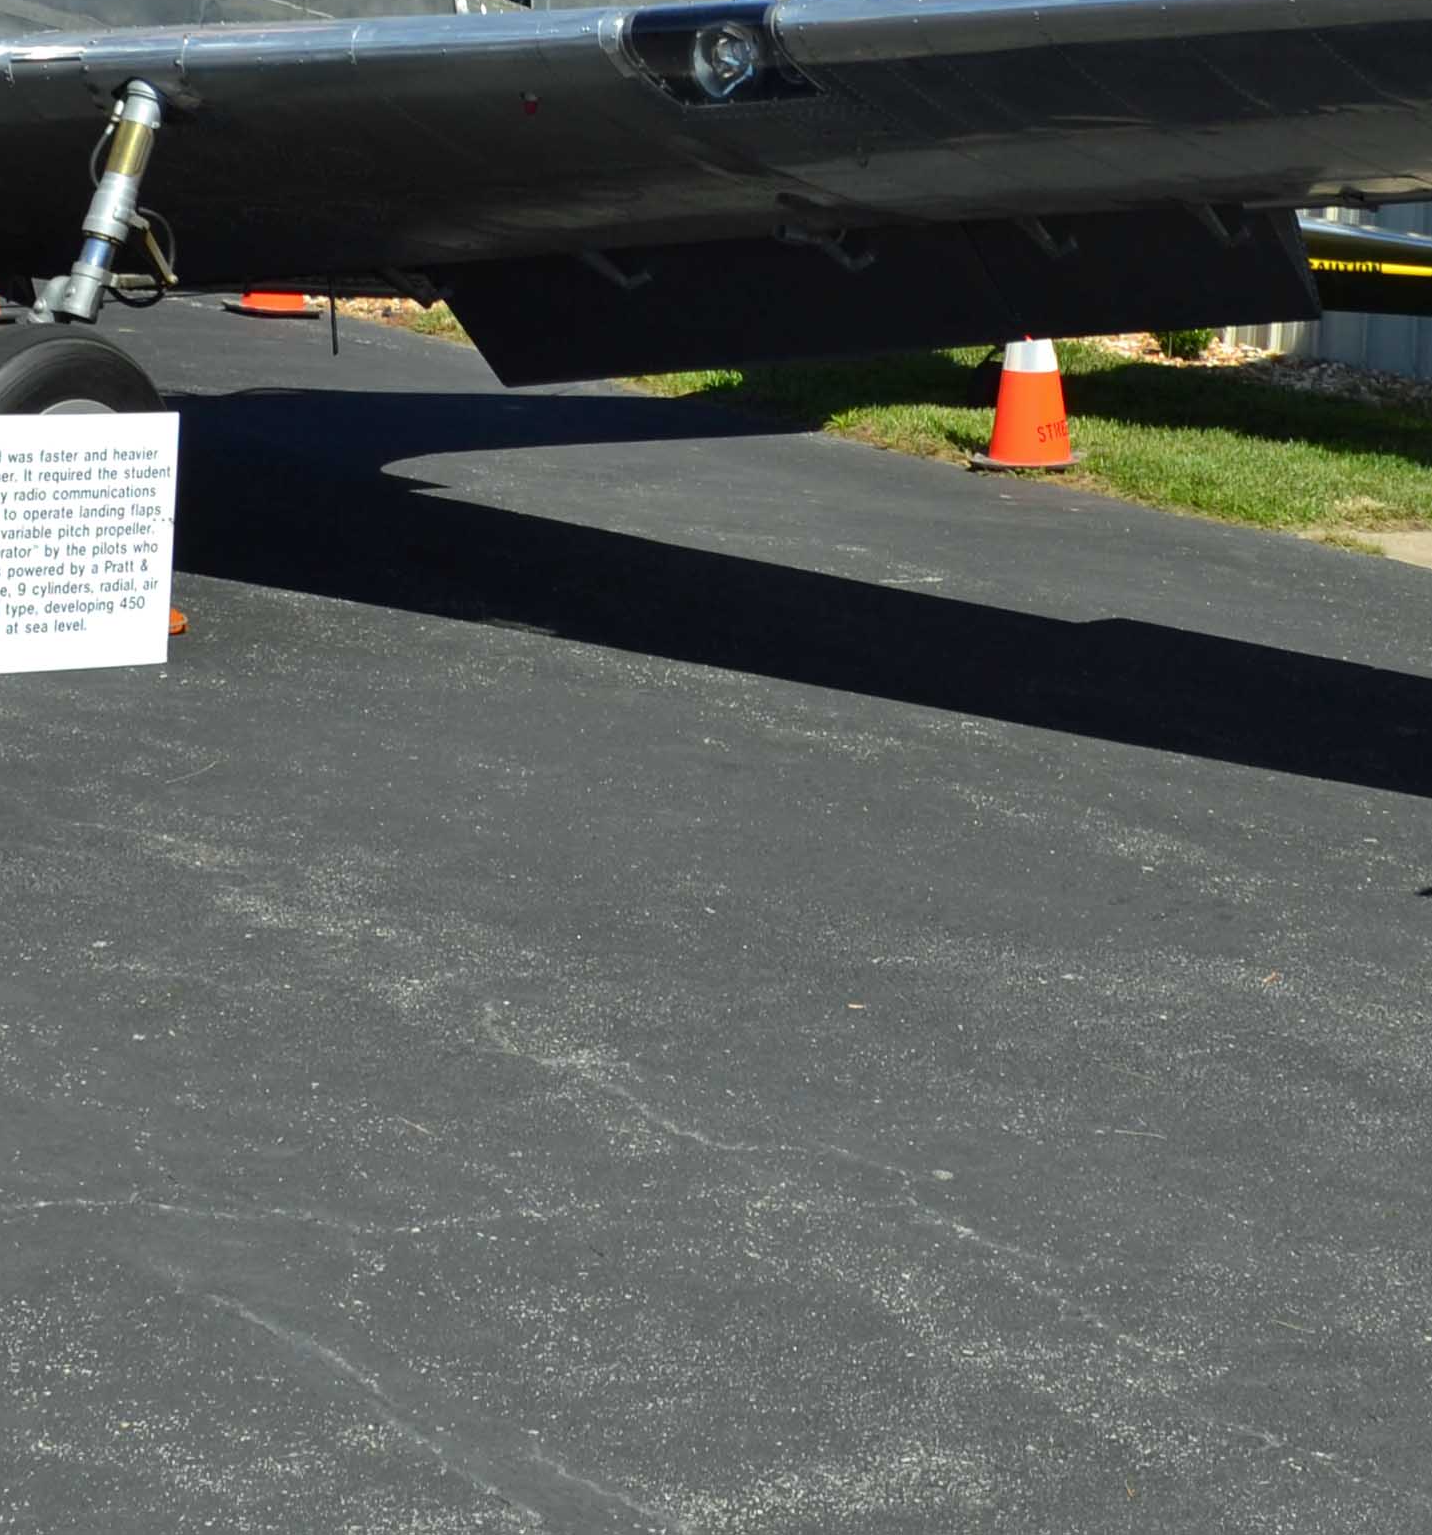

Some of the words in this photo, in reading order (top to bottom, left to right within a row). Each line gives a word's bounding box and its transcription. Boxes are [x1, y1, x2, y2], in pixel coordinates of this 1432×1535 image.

[8, 453, 33, 463] was
[40, 449, 78, 462] faster
[84, 449, 107, 461] and
[113, 448, 158, 461] heavier
[24, 469, 32, 481] It
[38, 467, 92, 484] required
[98, 467, 117, 479] the
[124, 466, 170, 479] student
[14, 488, 46, 501] radio
[53, 485, 156, 500] communications
[4, 509, 16, 521] to
[23, 507, 73, 521] operate
[79, 505, 125, 520] landing
[131, 504, 161, 518] flaps
[1, 526, 52, 540] variable
[58, 525, 90, 540] pitch
[45, 544, 59, 559] by
[67, 543, 86, 556] the
[92, 542, 127, 557] pilots
[133, 541, 158, 553] who
[8, 565, 64, 579] powered
[70, 563, 85, 576] by
[91, 564, 98, 574] a
[105, 561, 134, 573] Pratt
[140, 558, 148, 572] &
[18, 582, 26, 596] 9
[100, 579, 137, 592] radial,
[143, 577, 158, 591] air
[44, 599, 114, 614] developing
[120, 596, 145, 609] 450
[6, 622, 18, 634] at
[25, 623, 48, 633] sea
[54, 618, 87, 632] level.
